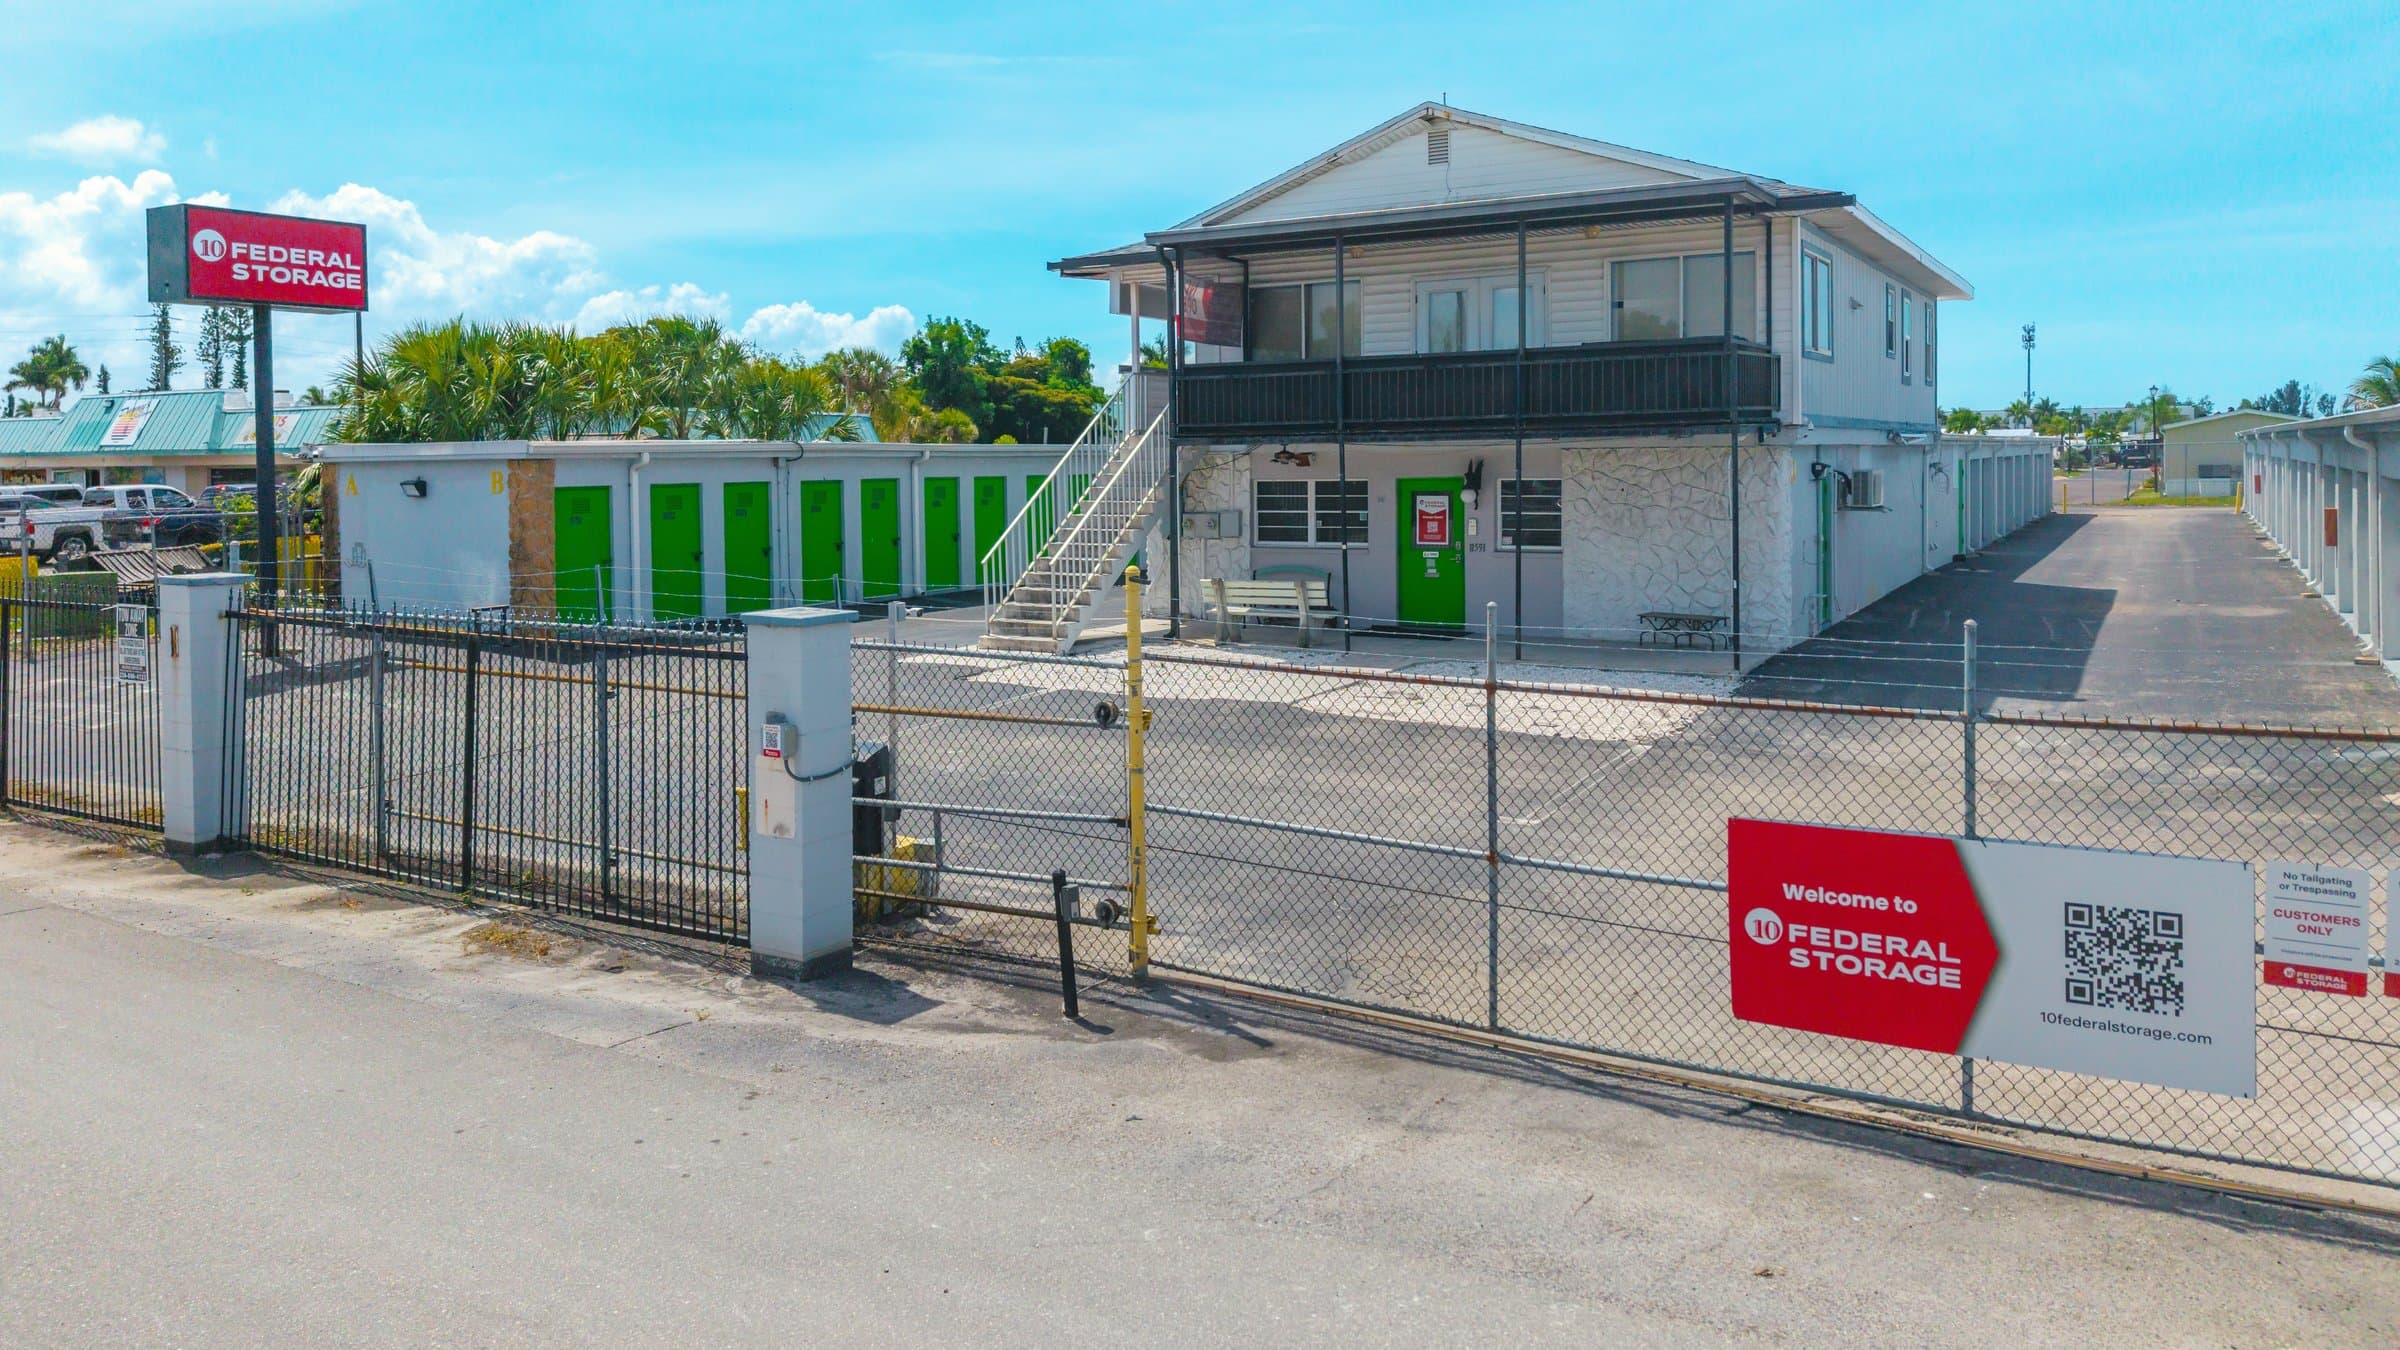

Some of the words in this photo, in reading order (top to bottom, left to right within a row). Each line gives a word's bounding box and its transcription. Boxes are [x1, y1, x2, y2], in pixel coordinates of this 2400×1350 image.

[199, 239, 225, 257] 10
[231, 242, 361, 270] FEDERAL
[232, 263, 362, 289] STORAGE
[346, 473, 358, 496] A
[490, 470, 504, 495] B
[2279, 883, 2290, 891] or
[2292, 884, 2357, 899] Trespassing
[2283, 871, 2298, 881] No
[2301, 873, 2353, 888] Tailgating
[1782, 882, 1889, 911] Welcome
[1893, 896, 1918, 914] to
[2273, 908, 2361, 927] CUSTOMERS
[1752, 919, 1780, 941] 10
[1788, 923, 1961, 964] FEDERAL
[2296, 923, 2333, 937] ONLY
[1789, 947, 1962, 989] STORAGE
[2296, 971, 2346, 984] FEDERAL
[2296, 978, 2348, 991] STORAGE
[2040, 1011, 2212, 1045] 10federalstorage.com
